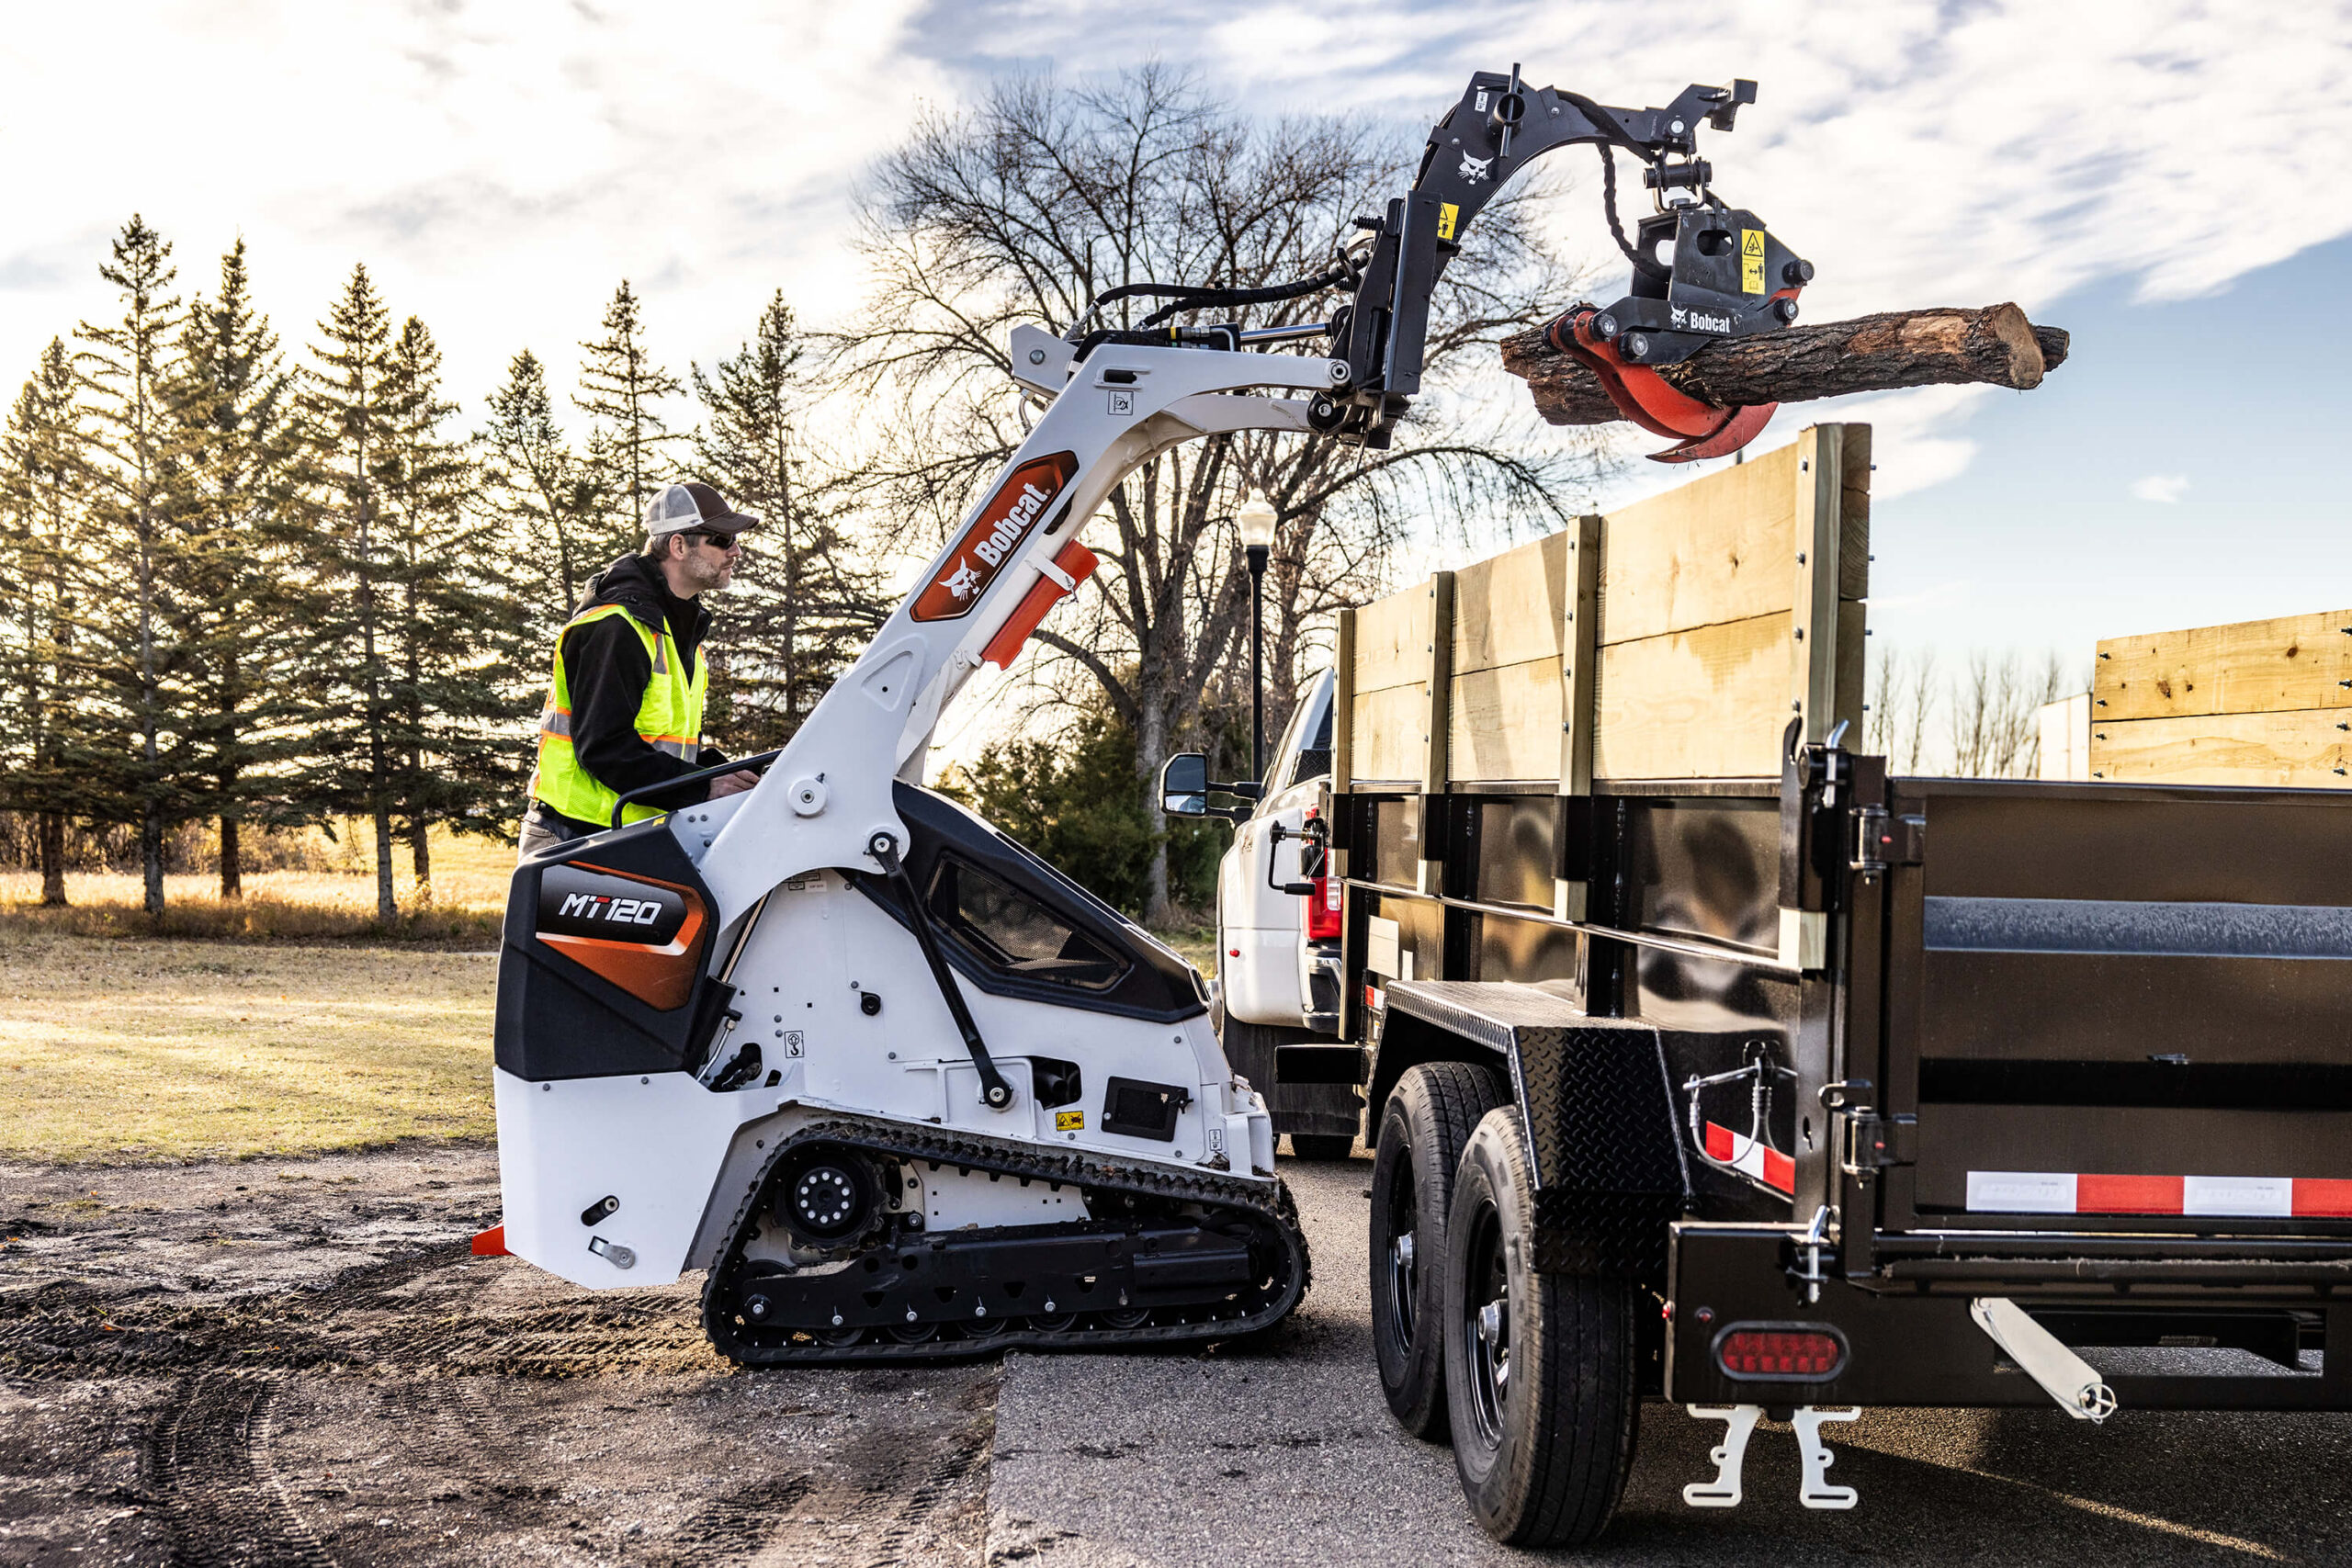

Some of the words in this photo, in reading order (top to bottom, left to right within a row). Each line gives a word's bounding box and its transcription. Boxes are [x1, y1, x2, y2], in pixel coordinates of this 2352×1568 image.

[1690, 311, 1731, 333] Bobcat
[973, 482, 1048, 568] Bobcat
[558, 893, 662, 925] MT120
